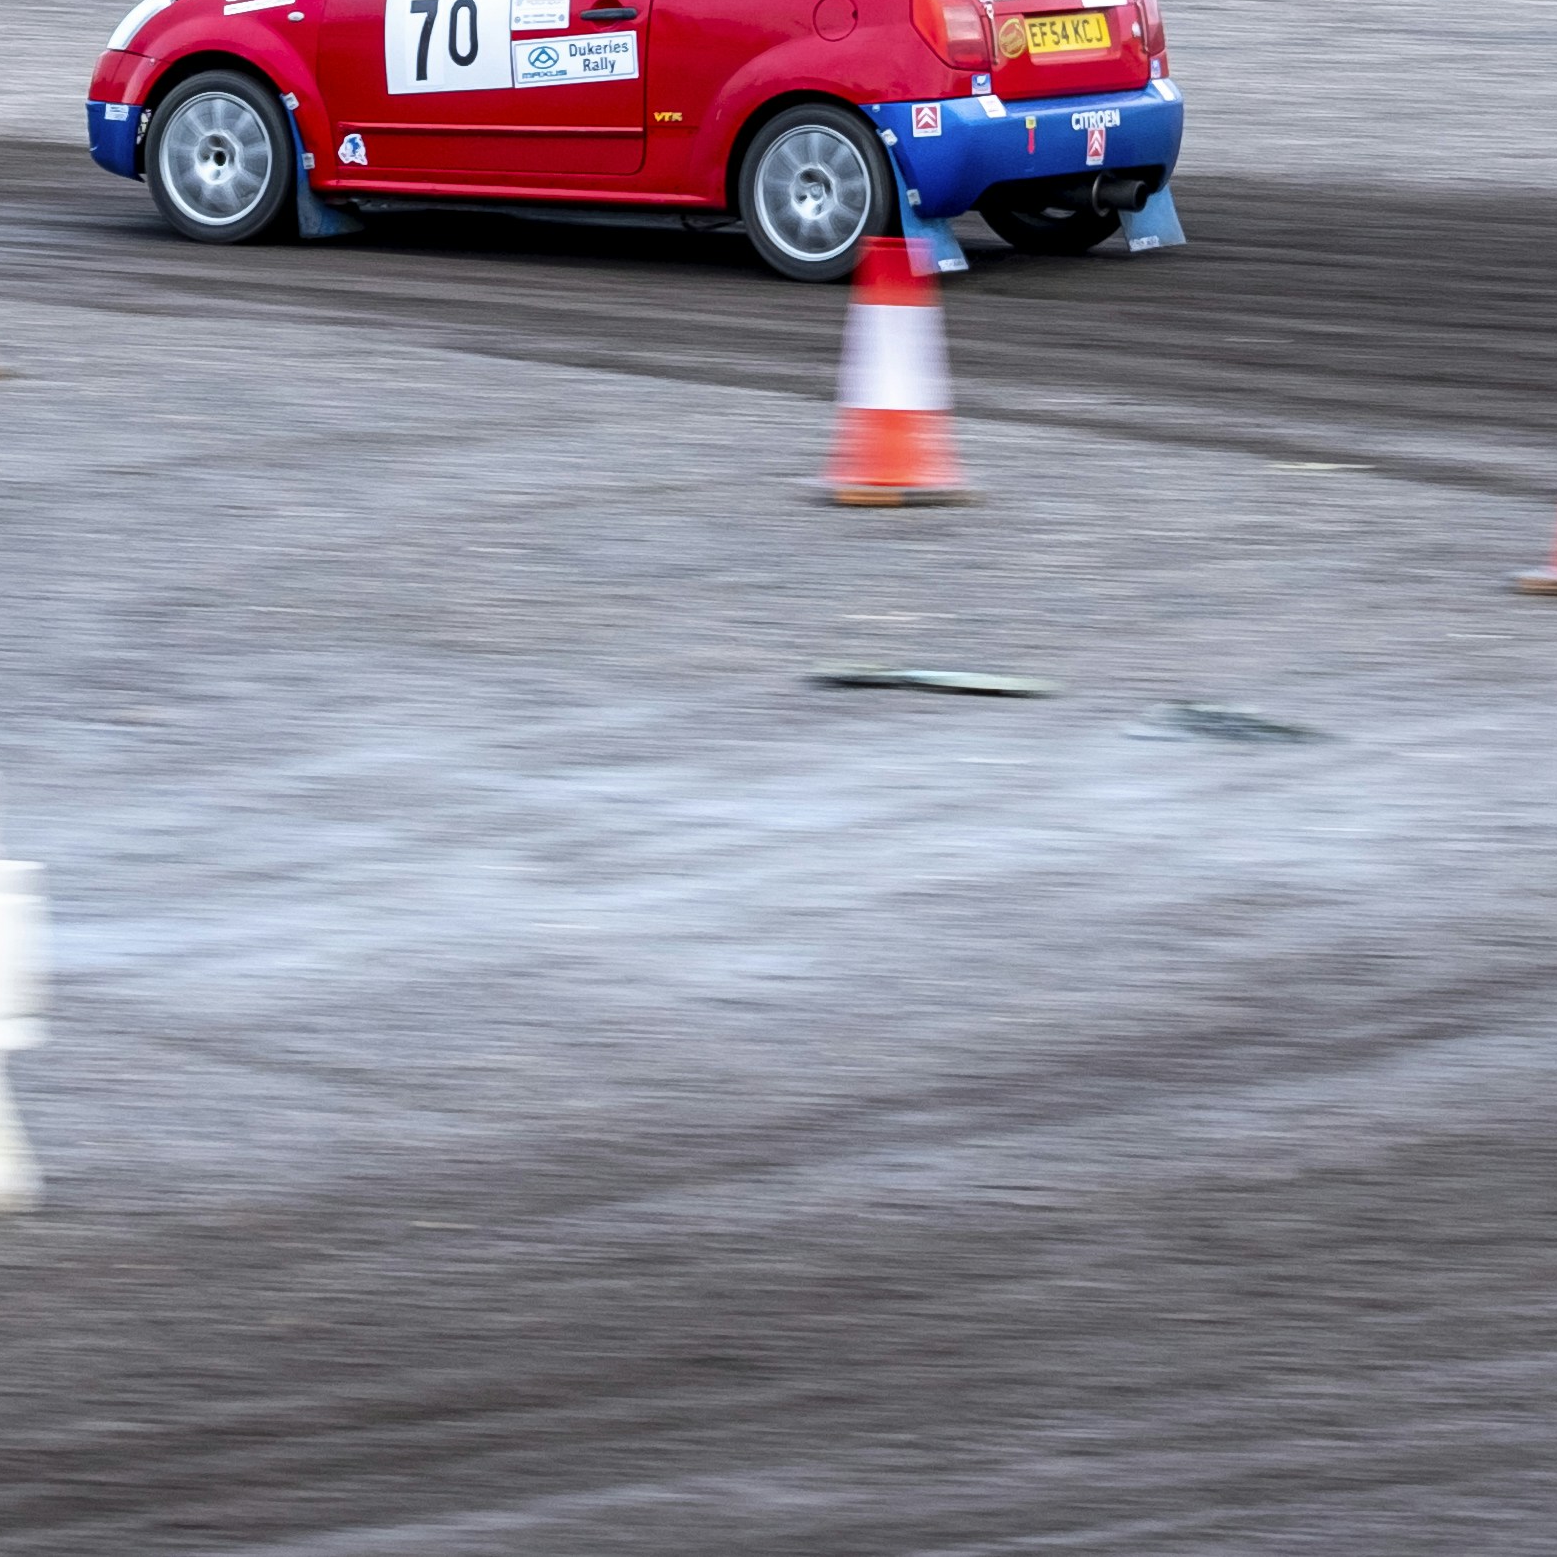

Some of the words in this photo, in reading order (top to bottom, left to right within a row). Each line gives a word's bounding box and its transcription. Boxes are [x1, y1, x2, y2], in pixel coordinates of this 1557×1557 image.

[1029, 19, 1070, 48] EF54
[1073, 18, 1104, 45] KCJ
[569, 40, 629, 57] Dukeries
[583, 57, 616, 73] Rally
